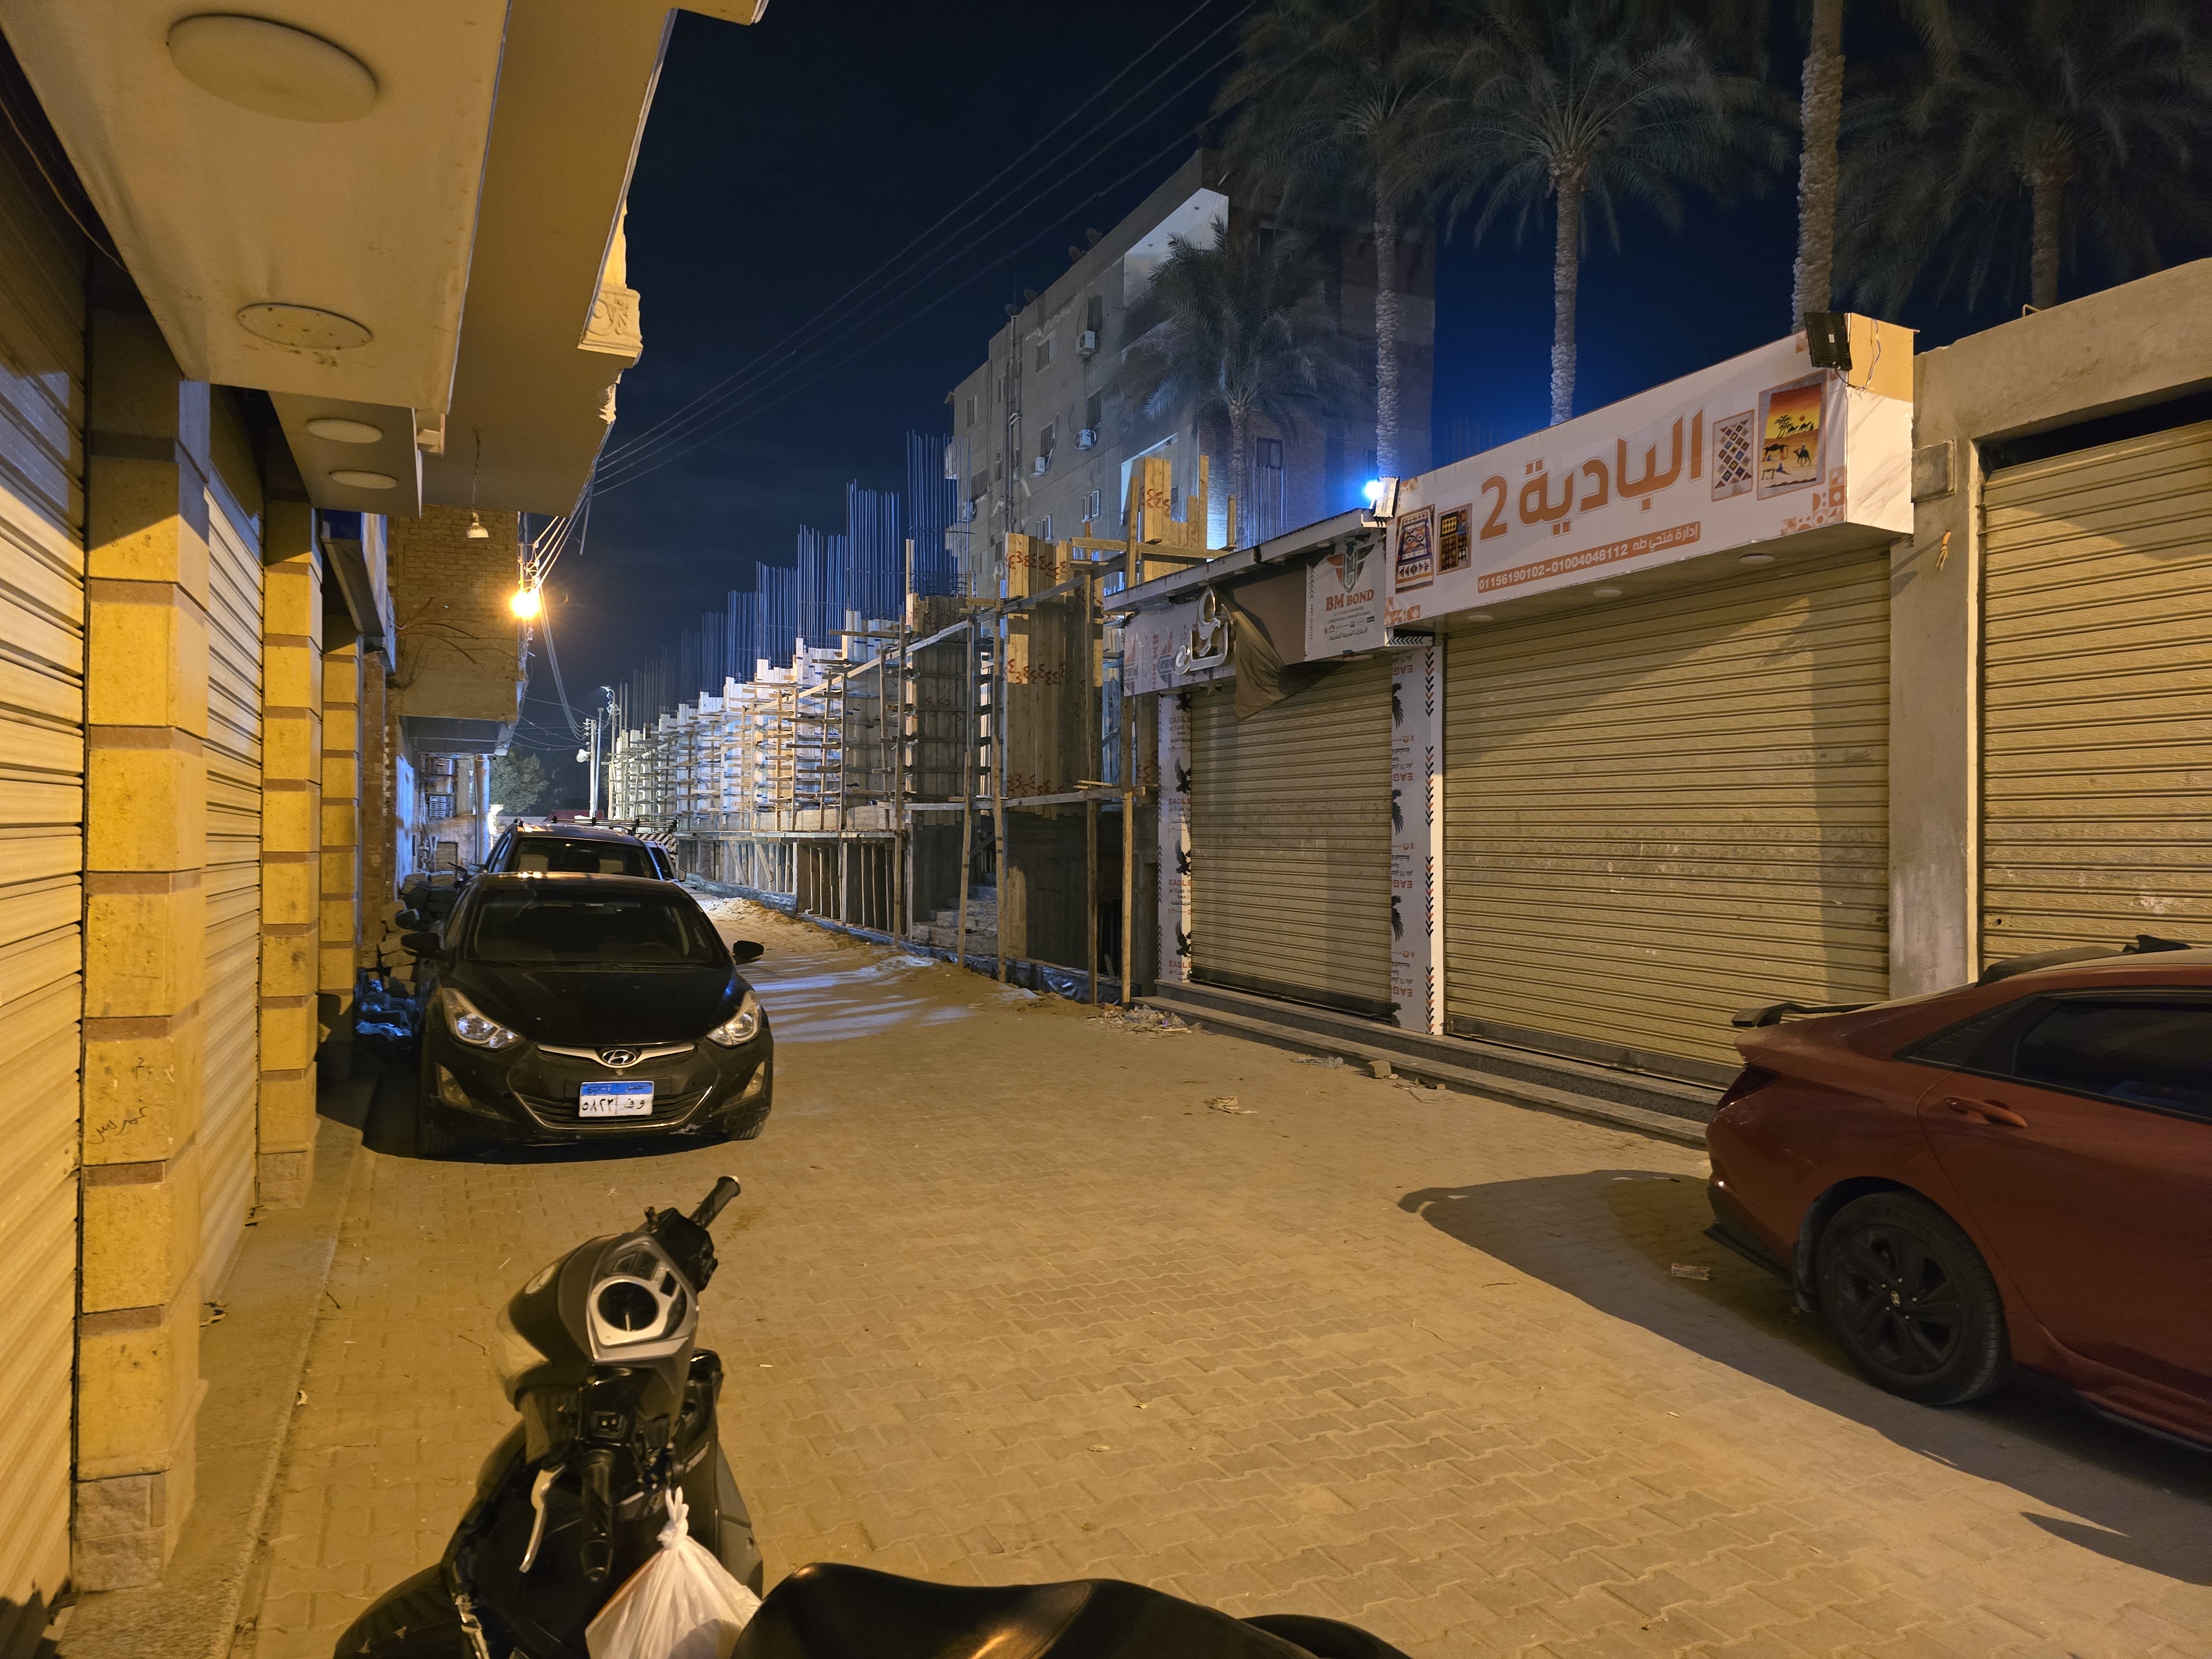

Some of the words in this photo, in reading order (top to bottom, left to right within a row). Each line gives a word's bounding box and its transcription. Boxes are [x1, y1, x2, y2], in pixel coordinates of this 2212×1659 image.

[1518, 407, 1703, 536] البادية
[1479, 473, 1509, 541] 2
[1648, 531, 1673, 551] فتحي
[1675, 523, 1699, 542] إدارة
[1633, 538, 1647, 551] طه
[1325, 593, 1344, 612] BM
[1346, 589, 1374, 606] BOND
